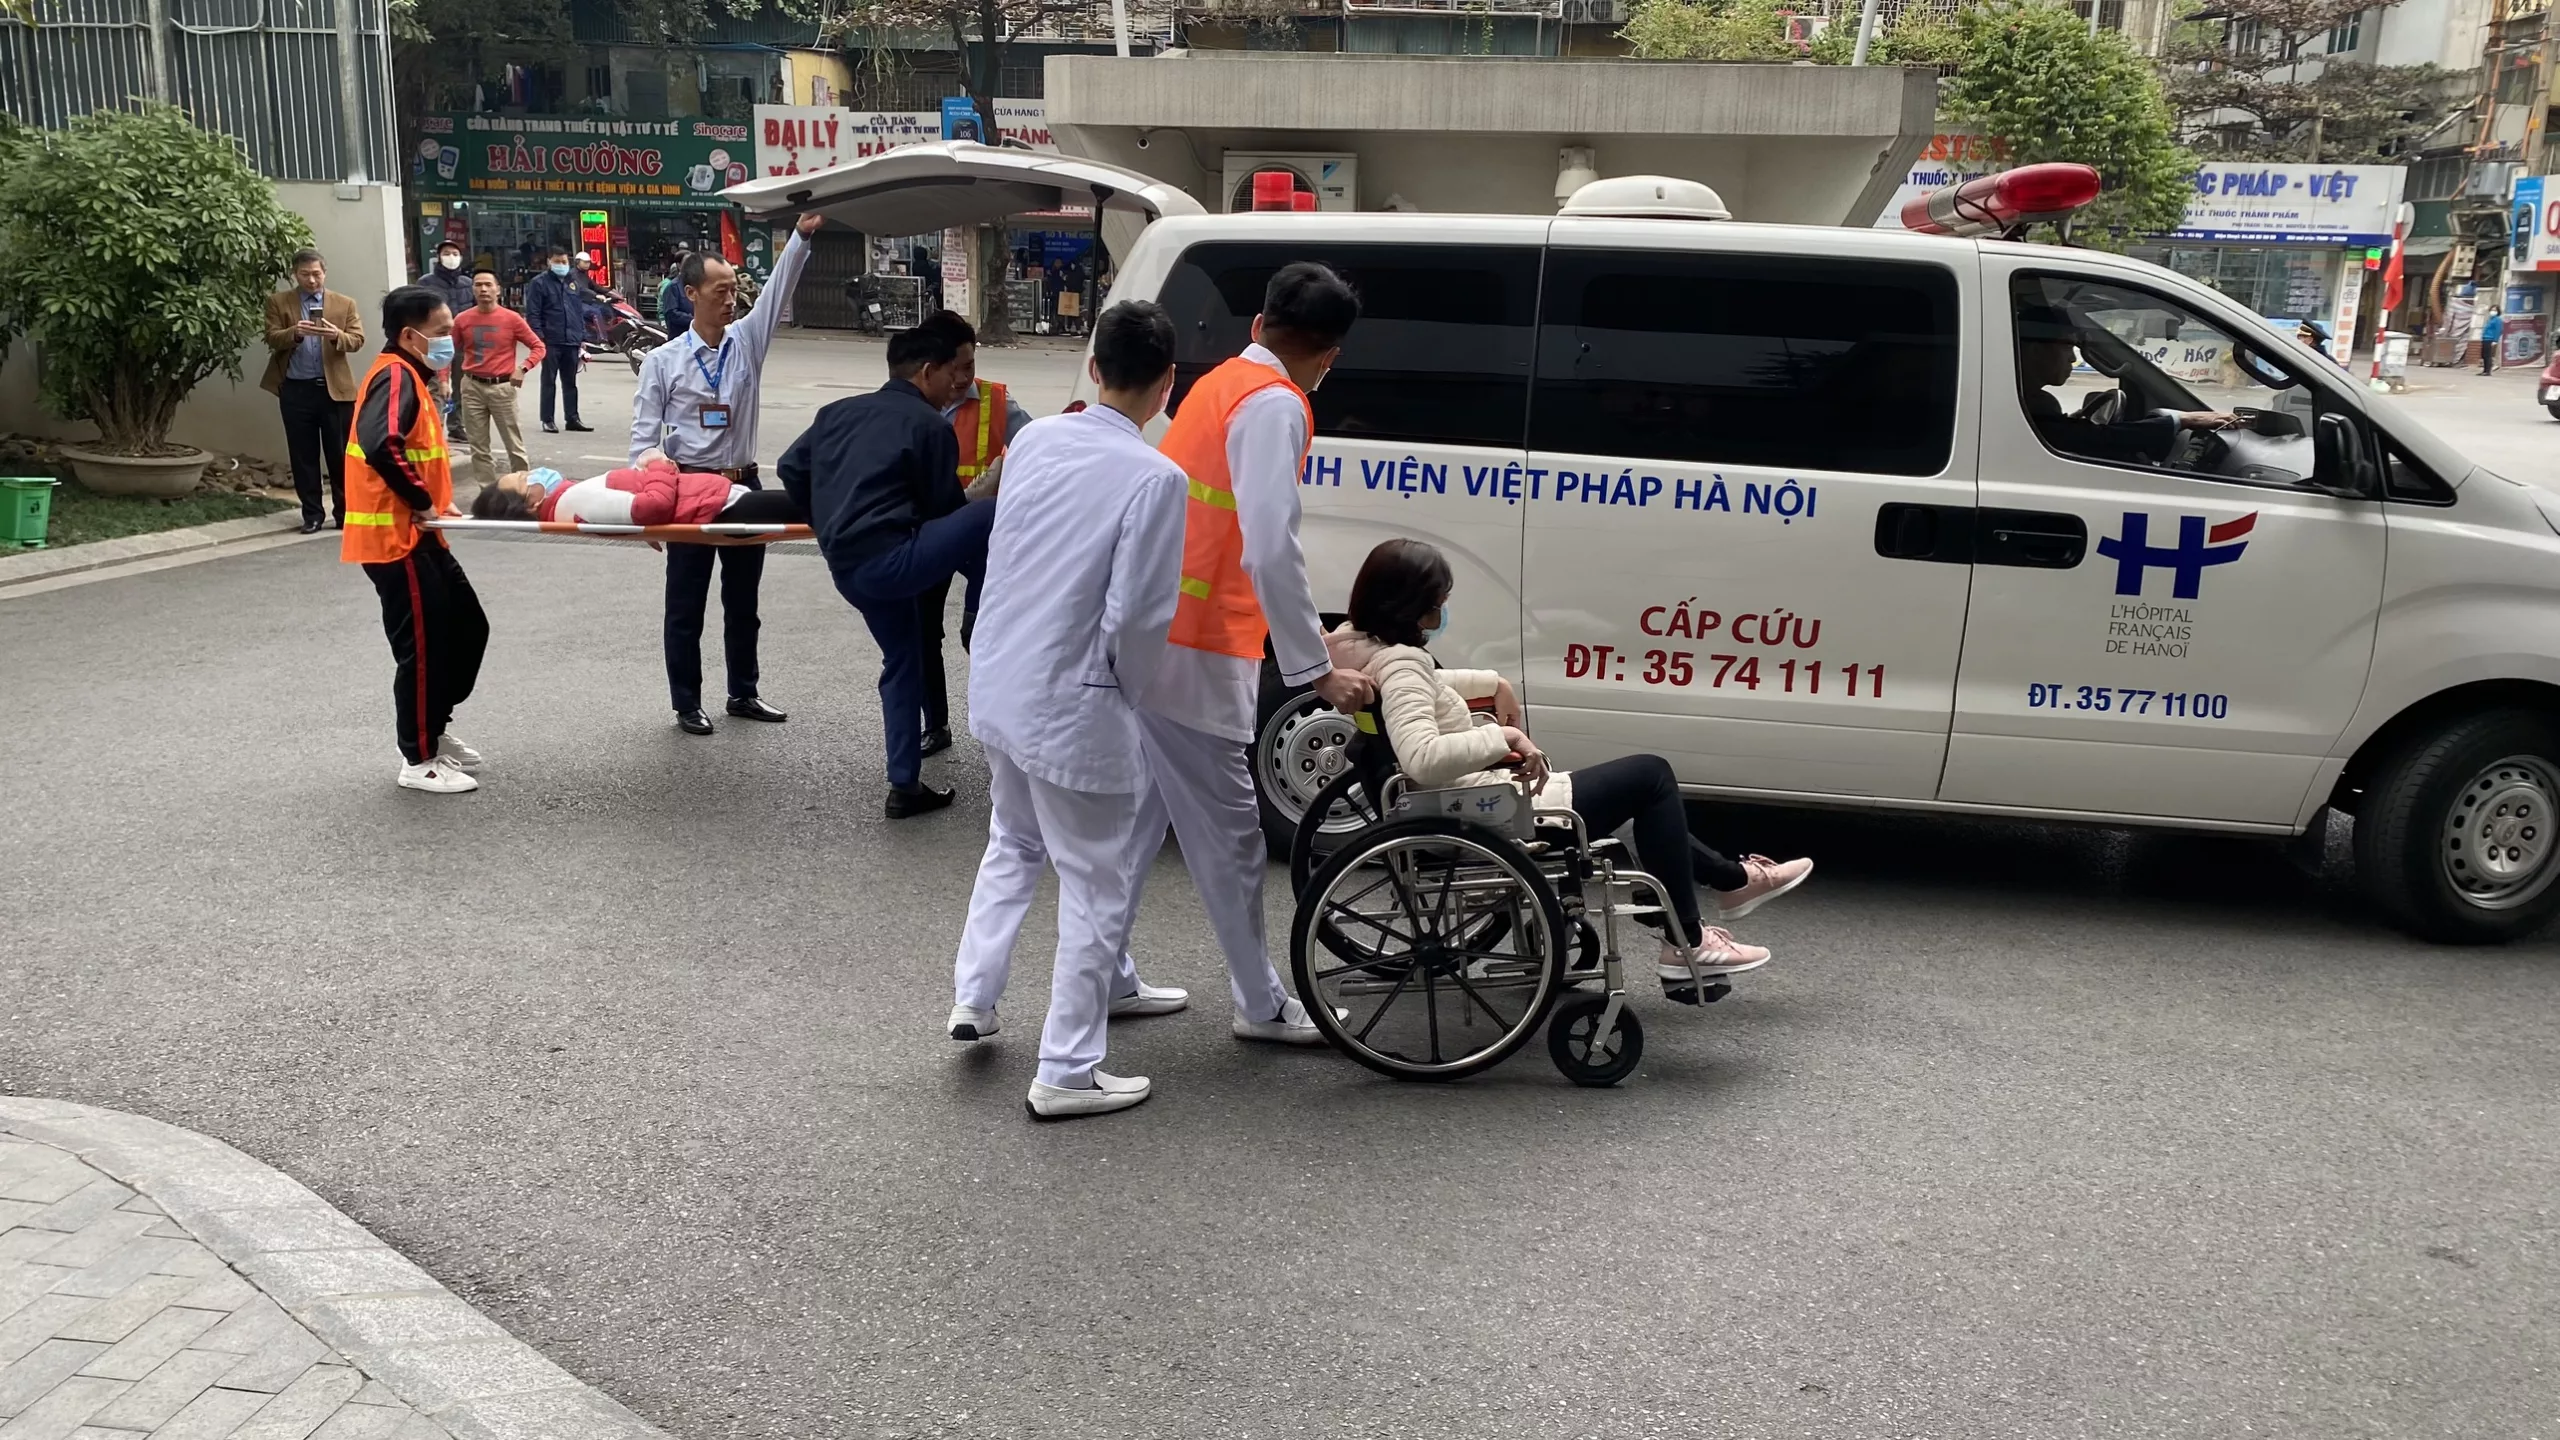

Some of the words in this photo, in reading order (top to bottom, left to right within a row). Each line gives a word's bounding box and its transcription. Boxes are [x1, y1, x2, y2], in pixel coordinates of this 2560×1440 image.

[869, 114, 888, 126] CỬA
[891, 115, 917, 126] HÀNG
[994, 106, 1012, 116] CỬA
[1014, 107, 1040, 117] HÀNG
[563, 118, 597, 134] THIẾT
[653, 123, 663, 136] Y
[663, 120, 680, 136] TẾ
[693, 122, 748, 137] Sinocare
[764, 118, 807, 151] ĐẠI
[812, 113, 839, 149] LÝ
[852, 125, 870, 134] THIẾT
[879, 126, 885, 134] Y
[886, 125, 894, 134] TẾ
[959, 130, 972, 138] 106
[486, 134, 547, 173] HẢI
[552, 139, 663, 177] CƯỜNG
[1912, 168, 1949, 186] THUỐC
[2222, 169, 2288, 197] PHÁP
[2293, 181, 2304, 189] -
[2309, 170, 2359, 203] VIỆT
[577, 182, 585, 192] Y
[638, 184, 645, 194] &
[2208, 208, 2237, 218] THUỐC
[2240, 209, 2270, 219] THÀNH
[2272, 210, 2299, 220] PHẨM
[472, 324, 498, 363] F
[1360, 455, 1448, 499] VIỆN
[1463, 462, 1549, 506] VIỆT
[1555, 468, 1663, 507] PHÁP
[1675, 474, 1732, 513] HÀ
[1743, 478, 1818, 526] NỘI
[2111, 602, 2194, 623] L'HÔPITAL
[1639, 597, 1722, 640] CẤP
[1730, 608, 1822, 650] CỨU
[2108, 621, 2192, 641] FRANÇAIS
[2104, 639, 2129, 654] DE
[2132, 641, 2191, 659] HANOÏ
[1563, 643, 1626, 681] ĐT:
[1643, 650, 1694, 688] 35
[1709, 655, 1761, 691] 74
[1777, 661, 1822, 694] 11
[1841, 663, 1885, 699] 11
